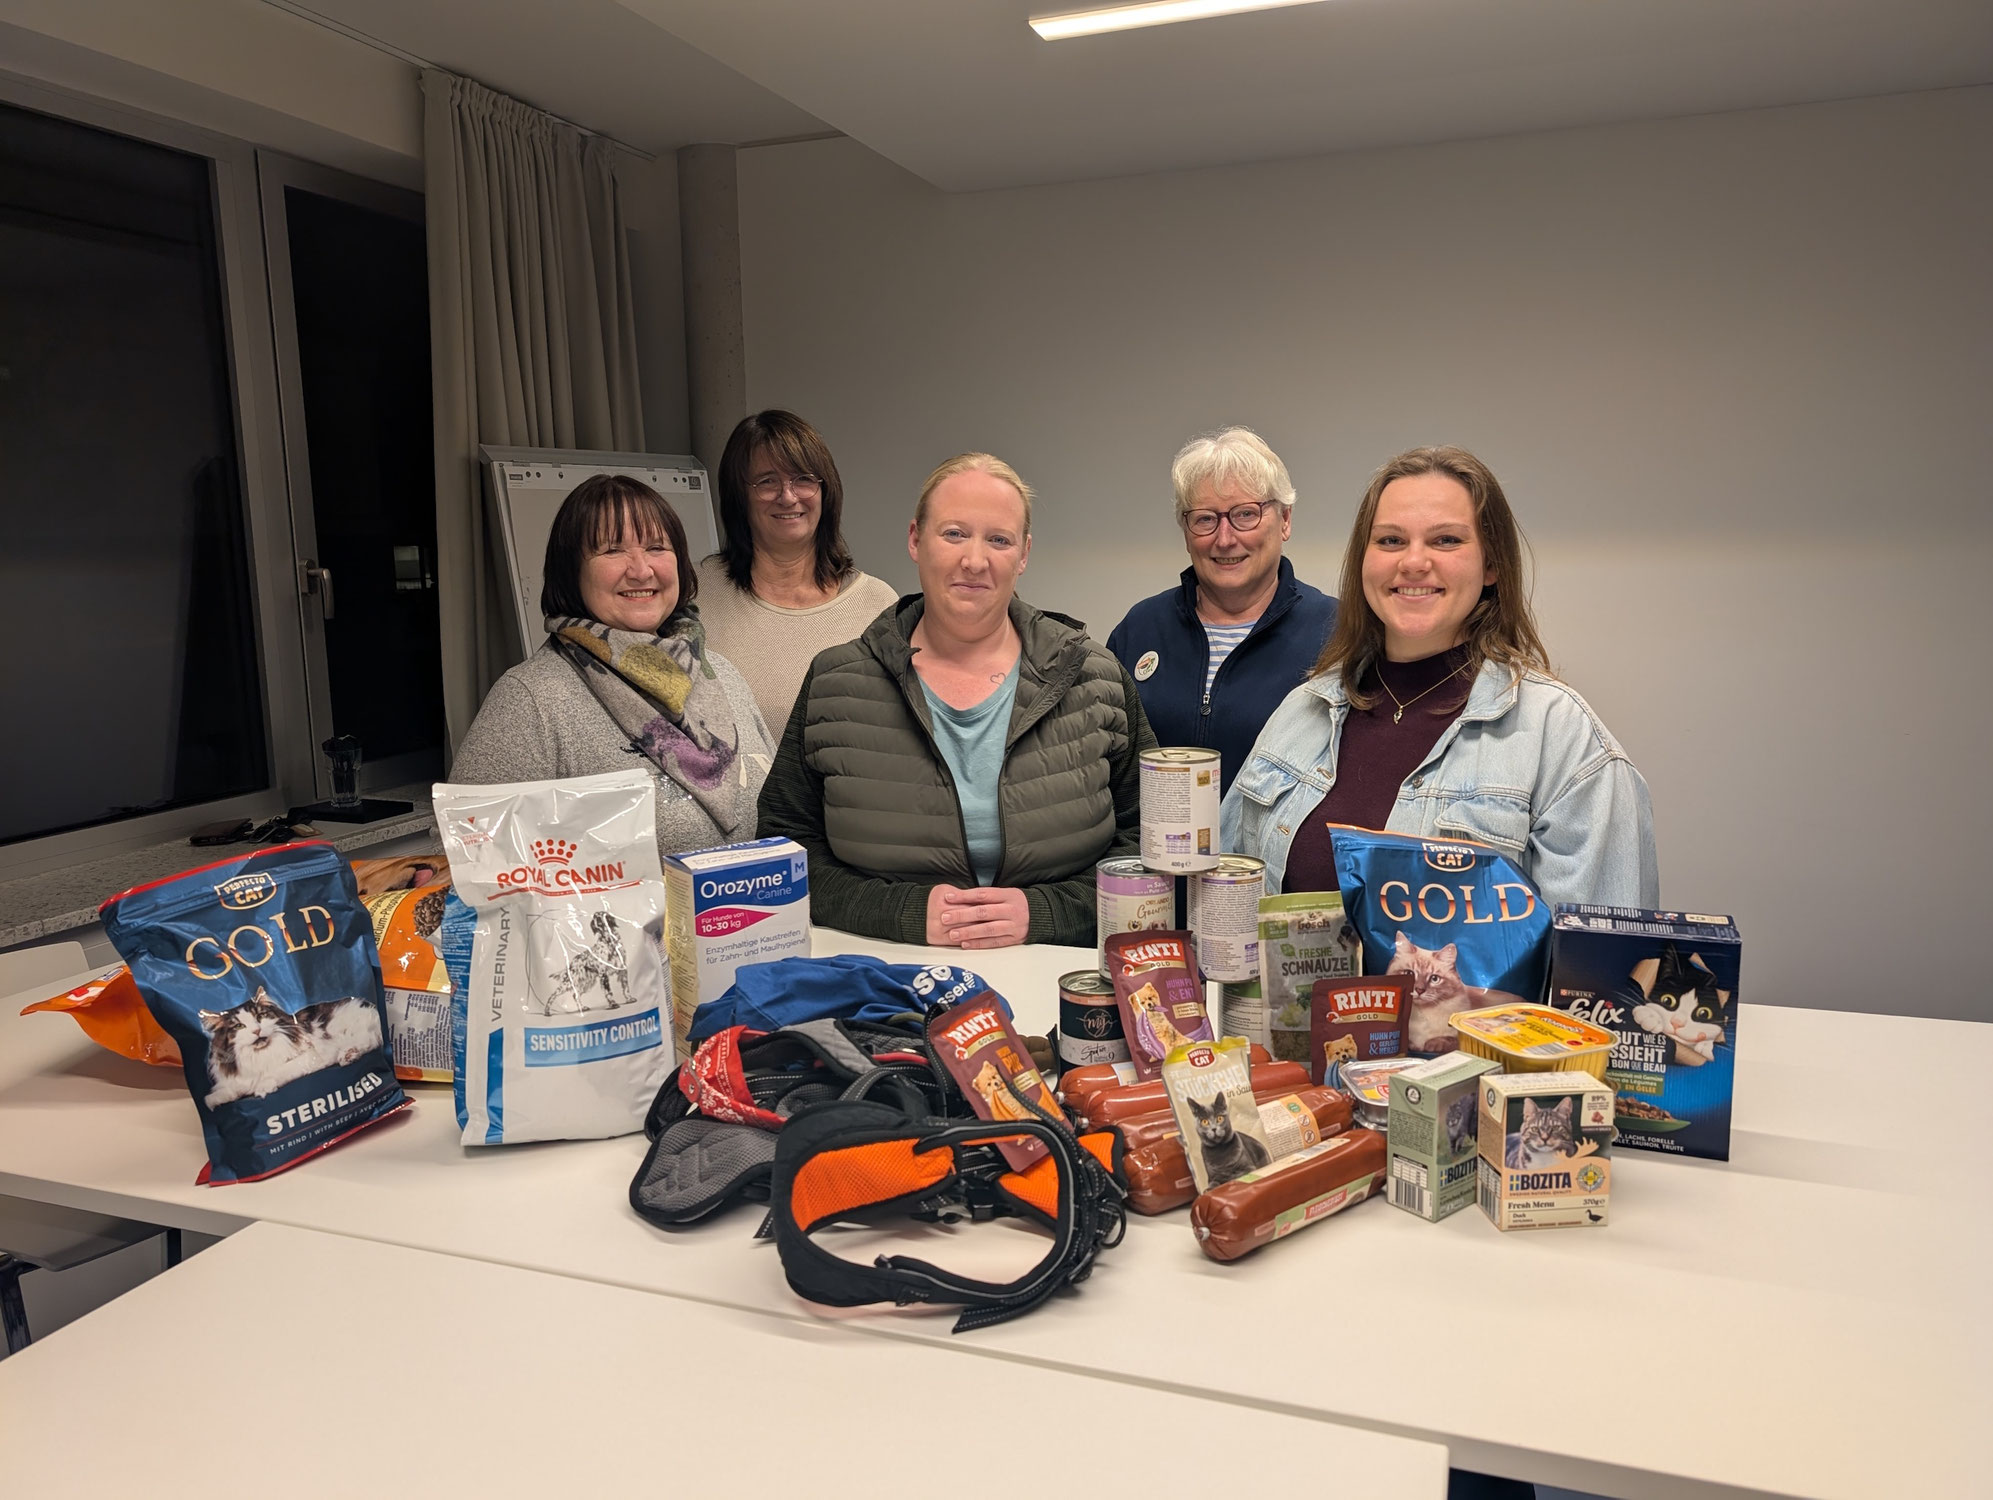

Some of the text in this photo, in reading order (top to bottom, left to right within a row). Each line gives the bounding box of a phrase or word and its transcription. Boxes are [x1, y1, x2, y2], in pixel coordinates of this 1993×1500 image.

[795, 862, 805, 873] M
[1437, 853, 1464, 866] CAT
[497, 862, 623, 888] ROYAL CANIN
[700, 871, 783, 899] Orozyme
[757, 886, 792, 900] Canine
[234, 886, 263, 905] CAT
[1380, 880, 1535, 924] GOLD
[713, 914, 732, 923] Hunde
[730, 920, 741, 928] kg
[185, 904, 336, 981] GOLD
[706, 929, 801, 955] Enzymhaltige Kaustreifen
[706, 937, 806, 965] für Zahn- und Maulhygiene
[1299, 946, 1332, 958] FRESHE
[491, 907, 511, 1023] VETERINARY
[1334, 990, 1396, 1011] RINTI
[530, 1016, 659, 1052] SENSITIVITY CONTROL
[946, 1010, 999, 1045] RINTI
[1643, 1032, 1657, 1044] WIE
[1657, 1034, 1667, 1045] ES
[1369, 1042, 1378, 1057] &
[1194, 1055, 1210, 1066] CAT
[1611, 1059, 1630, 1070] BON
[1643, 1063, 1667, 1074] BEAU
[1226, 1088, 1235, 1098] in
[266, 1072, 383, 1135] STERILISED
[270, 1144, 285, 1155] MIT
[287, 1135, 307, 1148] RIND
[314, 1123, 333, 1136] WITH
[1647, 1136, 1675, 1146] FORELLE
[1662, 1144, 1685, 1152] TRUITE
[1521, 1172, 1572, 1191] BOZITA
[1508, 1202, 1531, 1210] Fresh
[1532, 1201, 1555, 1209] Menu
